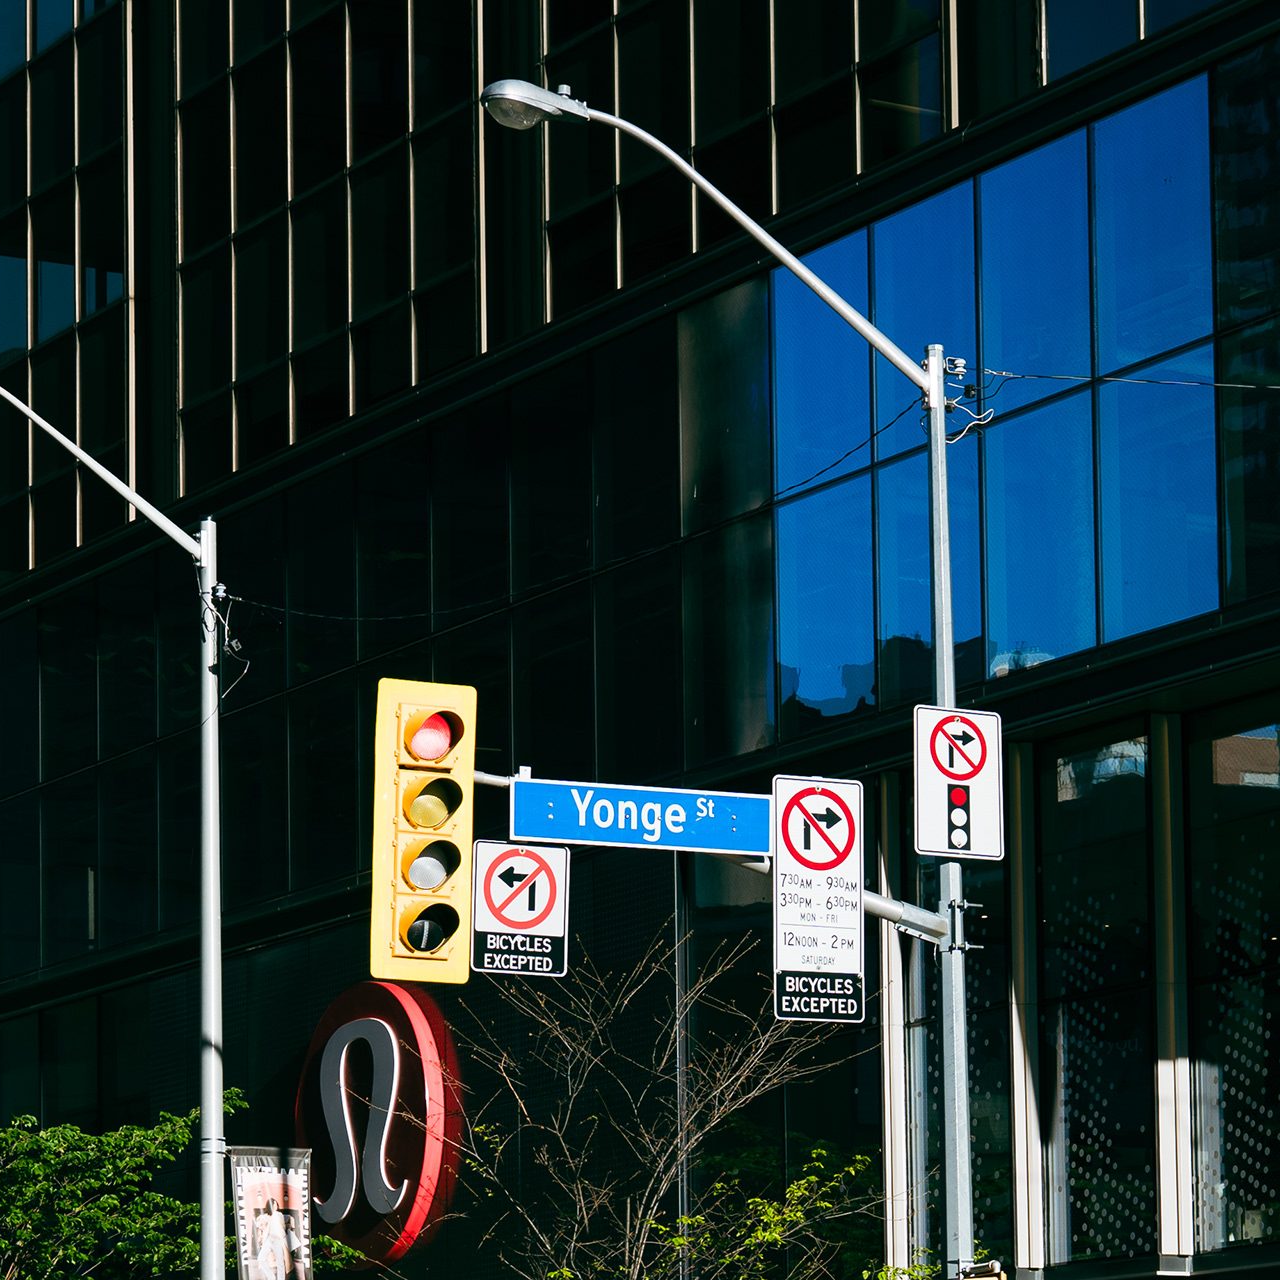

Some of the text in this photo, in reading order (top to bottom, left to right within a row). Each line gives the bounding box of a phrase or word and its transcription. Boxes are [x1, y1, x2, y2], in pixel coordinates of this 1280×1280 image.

[570, 788, 715, 842] Yonge St
[800, 912, 816, 922] MON
[826, 914, 838, 923] FRI
[486, 933, 552, 953] BICYCLES
[483, 953, 553, 972] EXCEPTED
[801, 955, 836, 966] SATURDAY
[785, 976, 853, 995] BICYCLES
[781, 996, 858, 1015] EXCEPTED
